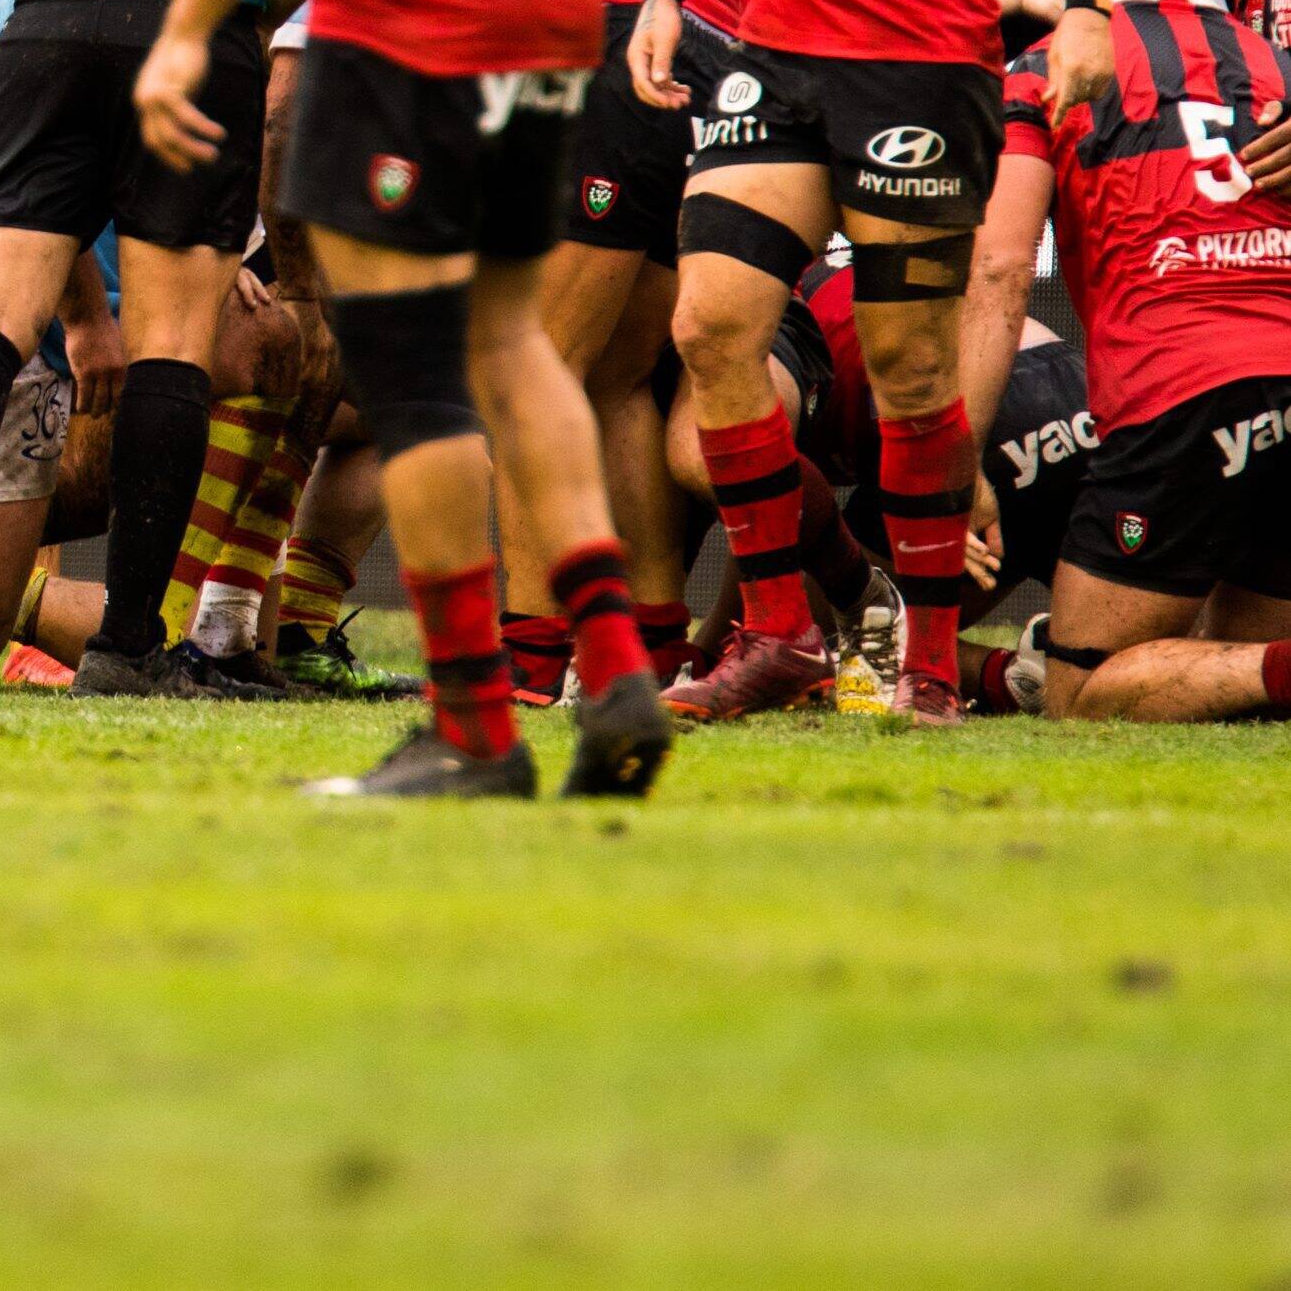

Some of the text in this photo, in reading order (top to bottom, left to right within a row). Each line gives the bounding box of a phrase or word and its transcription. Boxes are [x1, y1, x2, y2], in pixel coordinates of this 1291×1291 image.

[858, 169, 961, 197] HYUNDAI
[1177, 100, 1253, 203] 5
[1000, 411, 1100, 490] yac
[1213, 406, 1291, 478] ya
